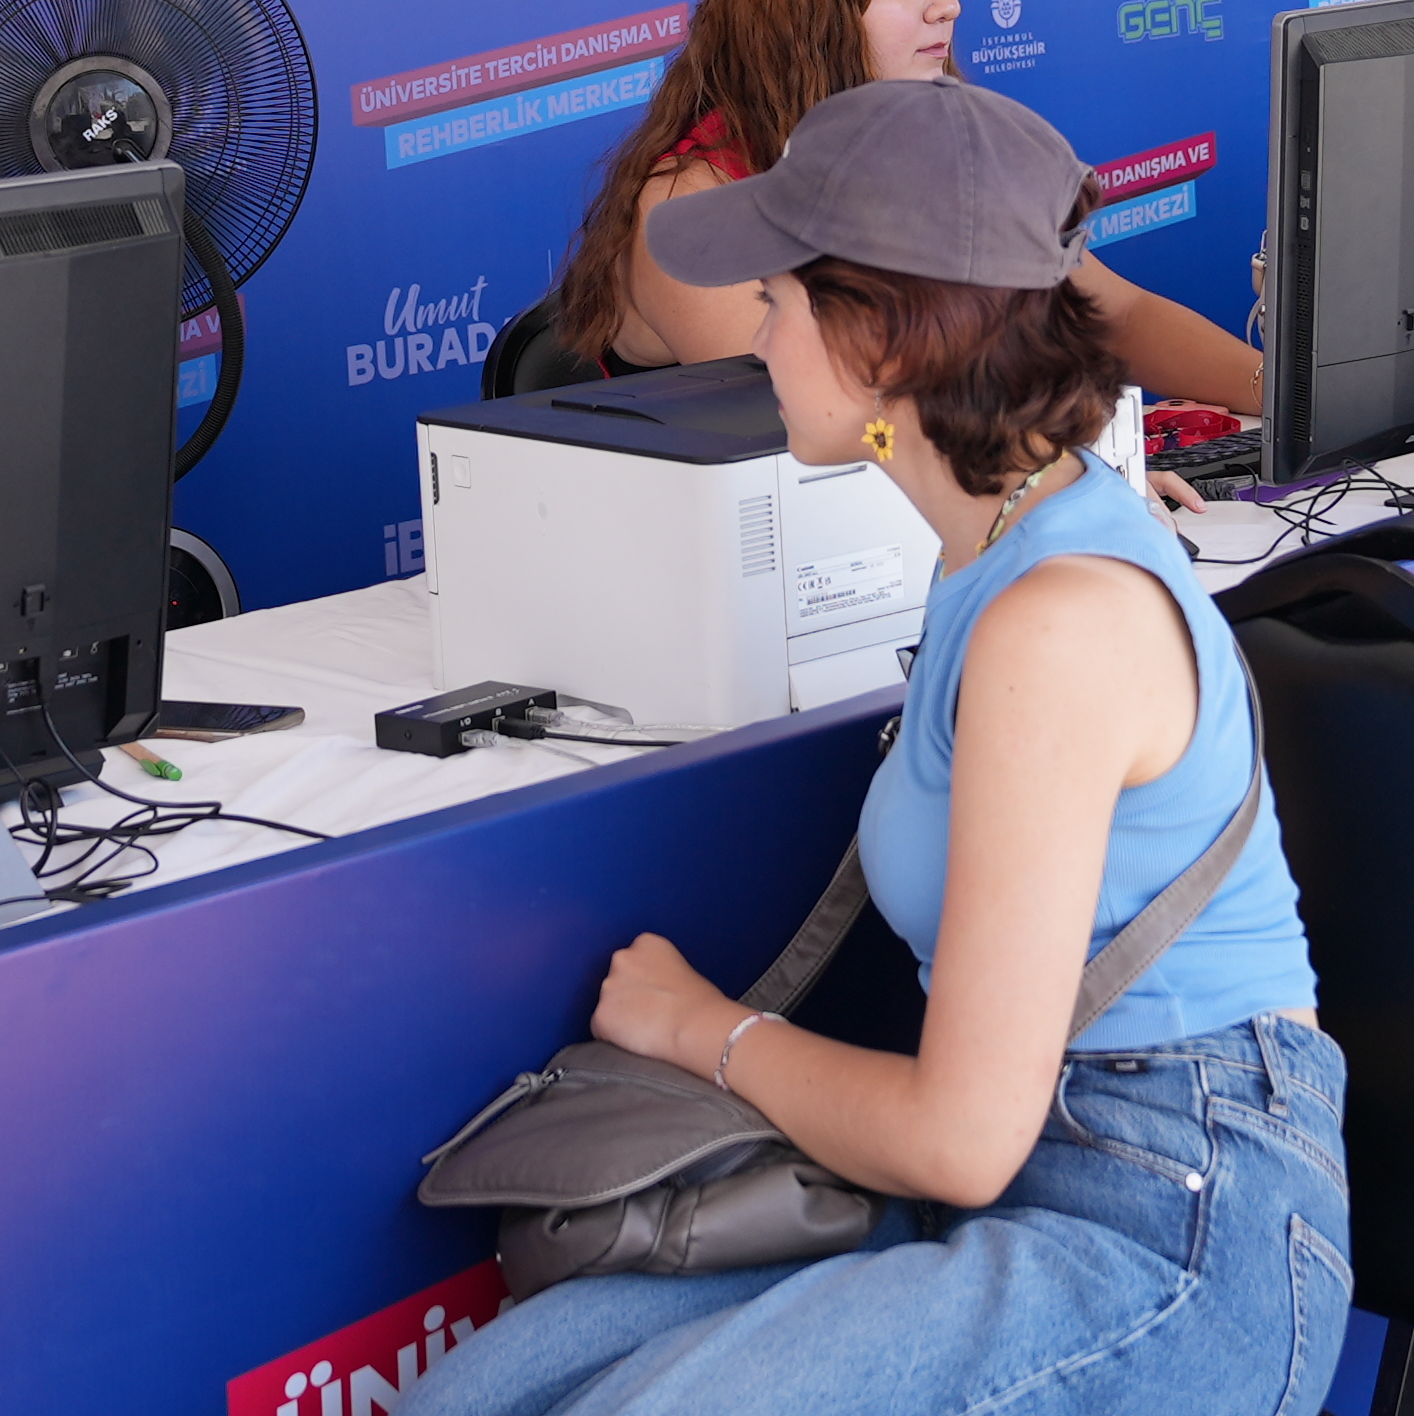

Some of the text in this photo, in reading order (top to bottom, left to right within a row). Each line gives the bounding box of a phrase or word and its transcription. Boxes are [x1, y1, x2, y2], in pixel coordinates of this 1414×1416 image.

[359, 14, 682, 114] ÜNİVERSİTE TERCİH DANIŞMA VE
[971, 41, 1047, 65] BÜYÜKŞEHİR
[82, 107, 119, 142] RAKS
[397, 61, 659, 160] REHBERLİK MERKEZİ
[1110, 153, 1187, 188] DANIŞMA
[1187, 141, 1211, 162] VE
[1100, 186, 1191, 239] MERKEZİ
[383, 275, 488, 337] Umut
[346, 317, 513, 387] BURAD
